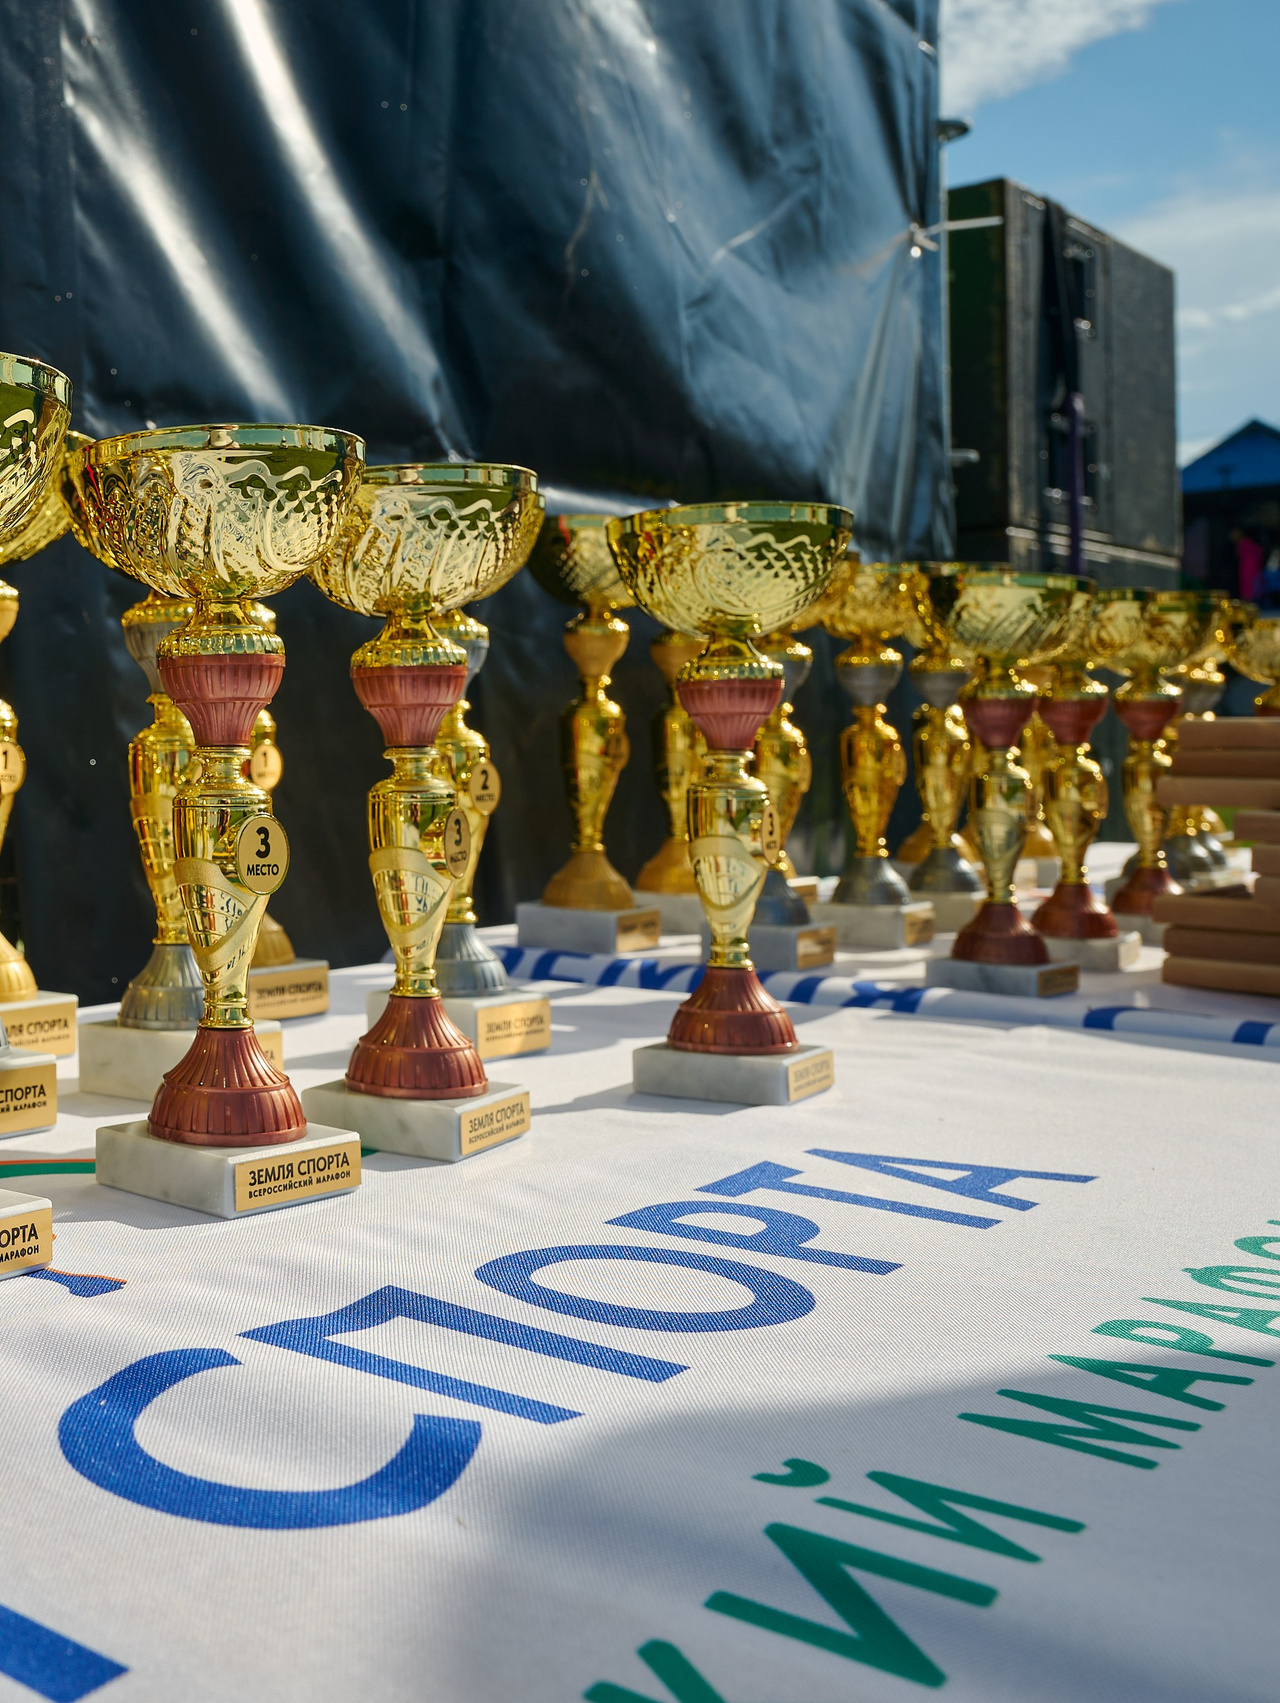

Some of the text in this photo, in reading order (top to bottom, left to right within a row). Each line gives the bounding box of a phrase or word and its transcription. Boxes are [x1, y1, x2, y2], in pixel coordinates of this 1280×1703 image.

[2, 750, 8, 769] 1
[480, 769, 489, 790] 2
[255, 826, 270, 859] 3
[454, 818, 462, 847] 3
[246, 864, 280, 876] МЕСТО
[13, 1101, 48, 1112] МАРАФОН
[468, 1101, 525, 1134] ЗЕМЛЯ СПОРТА
[248, 1152, 350, 1187] ЗЕМЛЯ СПОРТА
[248, 1170, 351, 1199] ВСЕРОССИЙСКИЙ МАРАФОН
[58, 1148, 1099, 1530] СПОРТА
